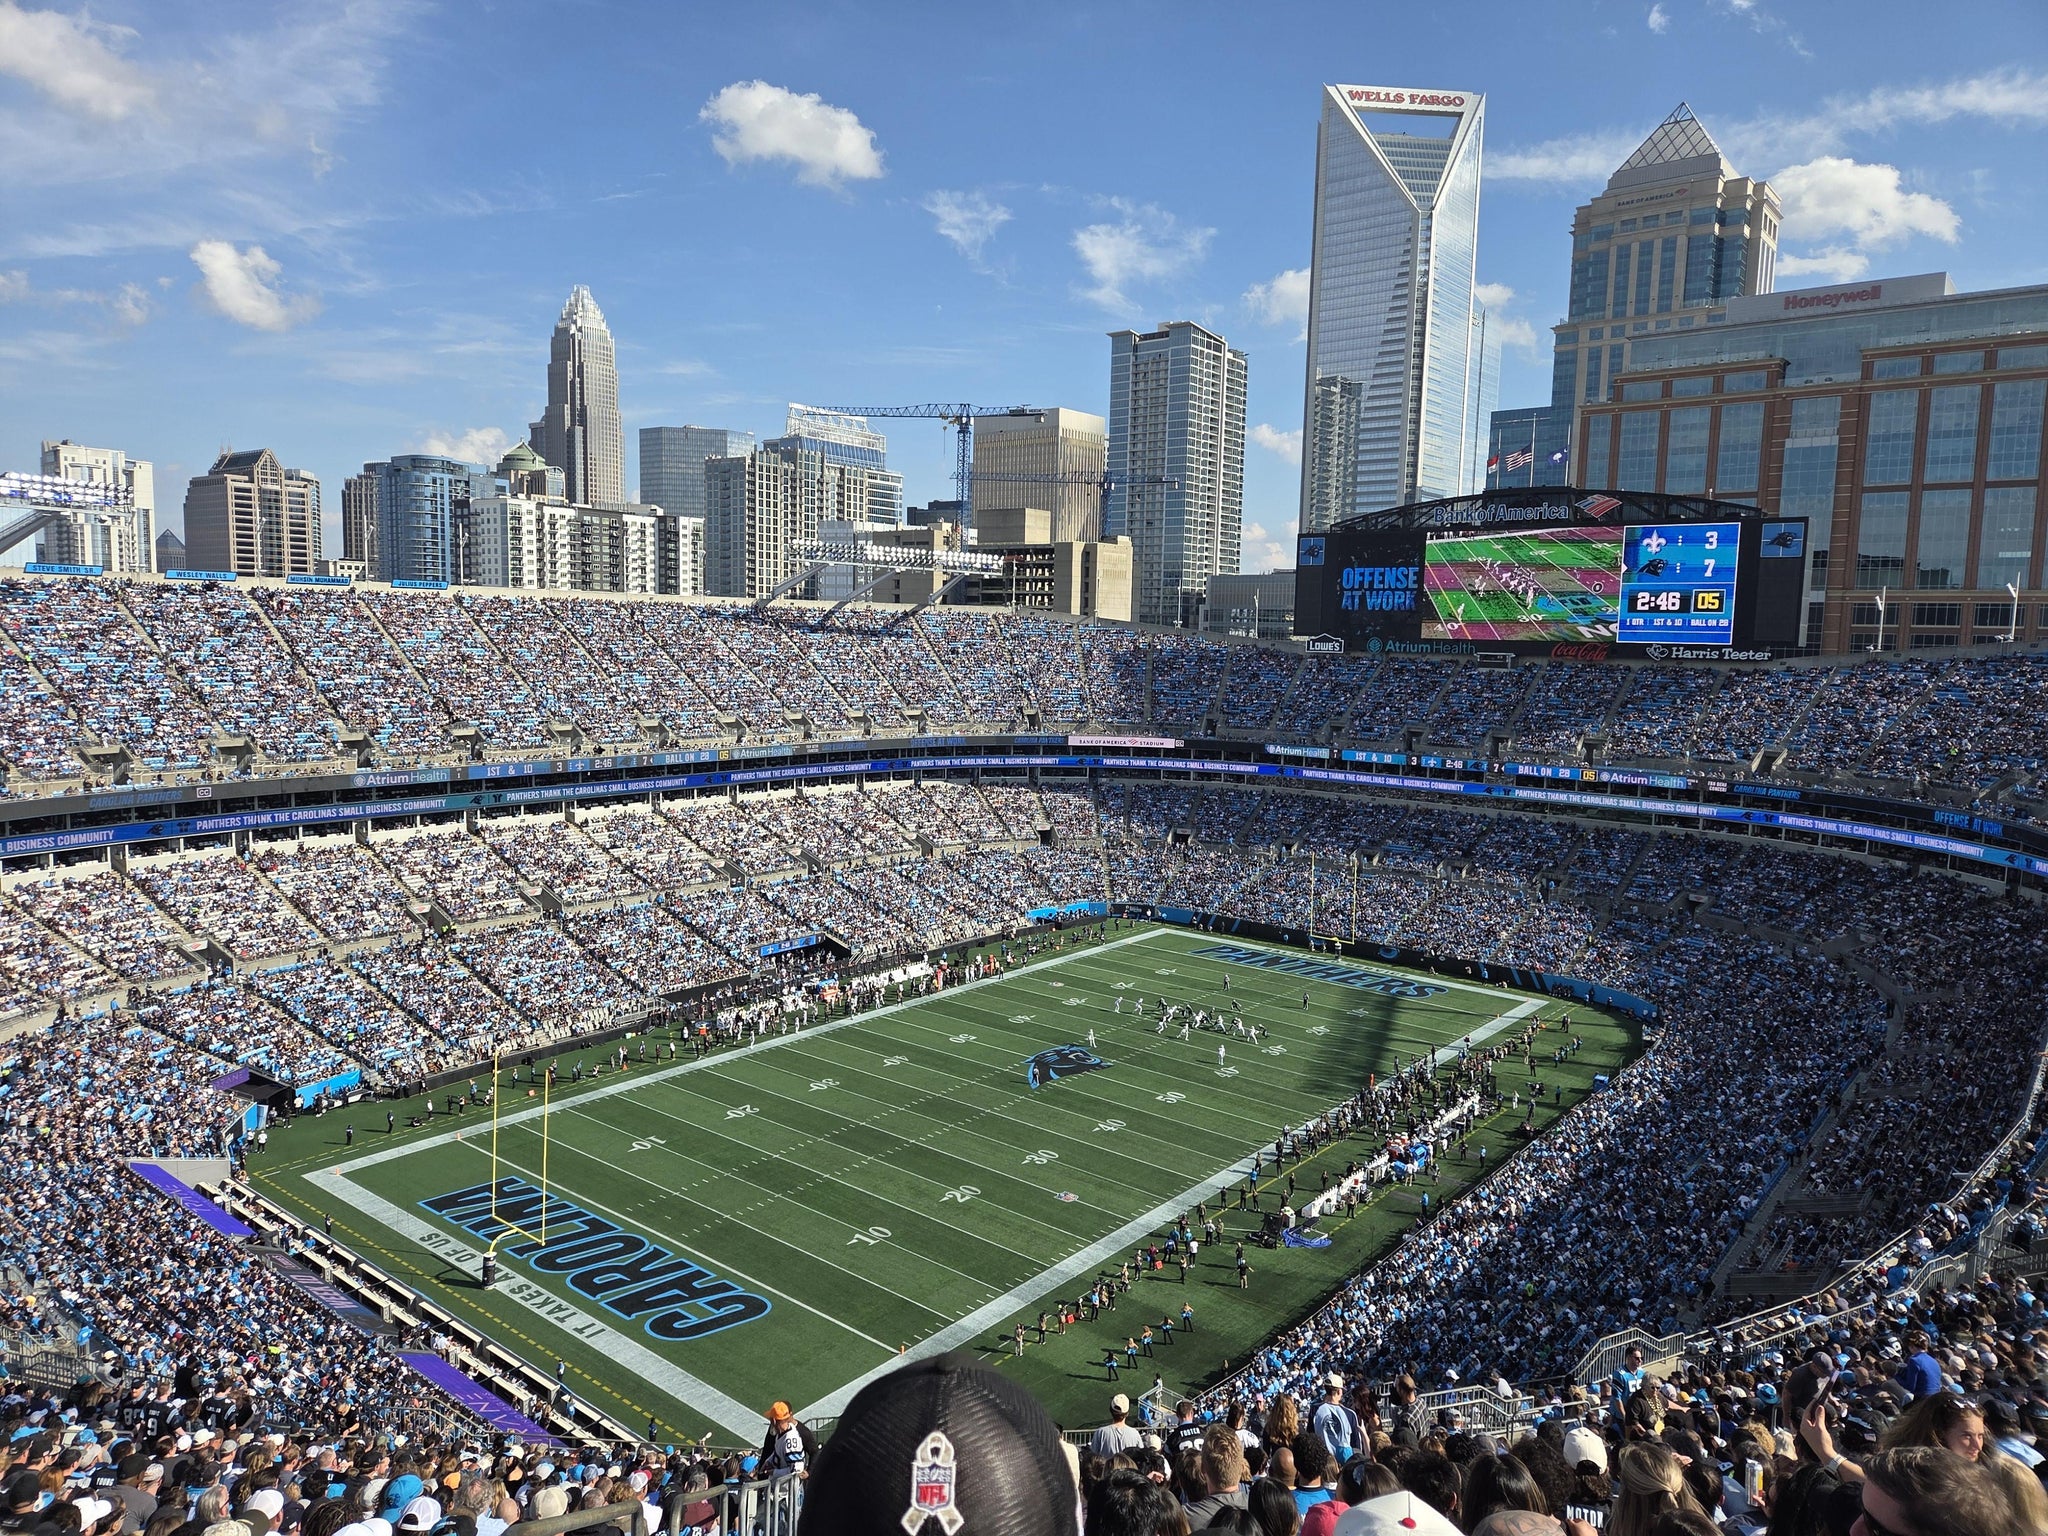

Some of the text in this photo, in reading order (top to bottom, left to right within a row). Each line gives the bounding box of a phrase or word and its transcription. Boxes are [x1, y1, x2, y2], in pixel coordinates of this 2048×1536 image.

[1347, 90, 1465, 107] WELLS FARGO
[1644, 192, 1674, 202] AMERICA
[1783, 285, 1882, 310] Honeywell
[1434, 502, 1569, 523] Bank of America
[1704, 531, 1718, 550] 3
[32, 565, 56, 573] STEVE
[58, 566, 81, 574] SMITH
[1704, 559, 1716, 577] 7
[314, 576, 349, 584] MUHAMMAD
[1342, 567, 1420, 589] OFFENSE
[1341, 591, 1417, 611] AT WORK
[1636, 592, 1681, 611] 2:46
[1697, 593, 1720, 610] 05
[1690, 619, 1706, 627] BALL
[1309, 641, 1341, 652] LOWE'S
[1385, 640, 1476, 655] Atrium Health
[1671, 646, 1772, 661] Harris Teeter
[665, 753, 683, 764] BALL
[683, 752, 695, 762] ON
[740, 748, 767, 758] Atrium
[767, 747, 793, 757] Health
[1275, 746, 1329, 758] Atrium Health
[1355, 752, 1367, 761] 1ST
[1383, 754, 1392, 763] 10
[557, 762, 563, 772] 3
[594, 759, 612, 769] 2:46
[642, 756, 648, 765] 7
[1411, 756, 1417, 766] 3
[1493, 764, 1499, 773] 7
[366, 770, 447, 786] Atrium Health
[487, 764, 533, 777] 1ST & 10
[1518, 765, 1595, 780] BALL ON 28 05
[1610, 772, 1685, 788] Atrium Health
[506, 778, 688, 802] PANTHERS THANK THE CAROLINAS SMALL BUSINESS COMMUNITY
[1733, 785, 1766, 797] CAROLINA
[1767, 788, 1801, 800] PANTHERS
[89, 790, 183, 809] CAROLINA PANTHERS
[1515, 789, 1718, 816] PANTHERS THANK THE CAROLINAS SMALL BUSINESS COMMUNITY
[197, 800, 446, 831] PANTHERS THANK THE CAROLINAS SMALL BUSINESS COMMUNITY
[6, 830, 114, 852] BUSINESS COMMUNITY
[1779, 816, 1985, 857] PANTHERS THANK THE CAROLINAS SMALL BUSINESS COMMUNITY
[1191, 944, 1449, 1000] PANTHERS
[1155, 1091, 1186, 1104] 50
[727, 1104, 761, 1119] 20
[1097, 1118, 1127, 1132] 40
[1025, 1149, 1059, 1165] 30
[944, 1185, 982, 1203] 20
[853, 1226, 893, 1246] 10
[416, 1174, 774, 1343] CAROLINA
[419, 1232, 608, 1341] IT TAKES OF US
[785, 1437, 798, 1449] 89
[918, 1484, 948, 1505] NFL
